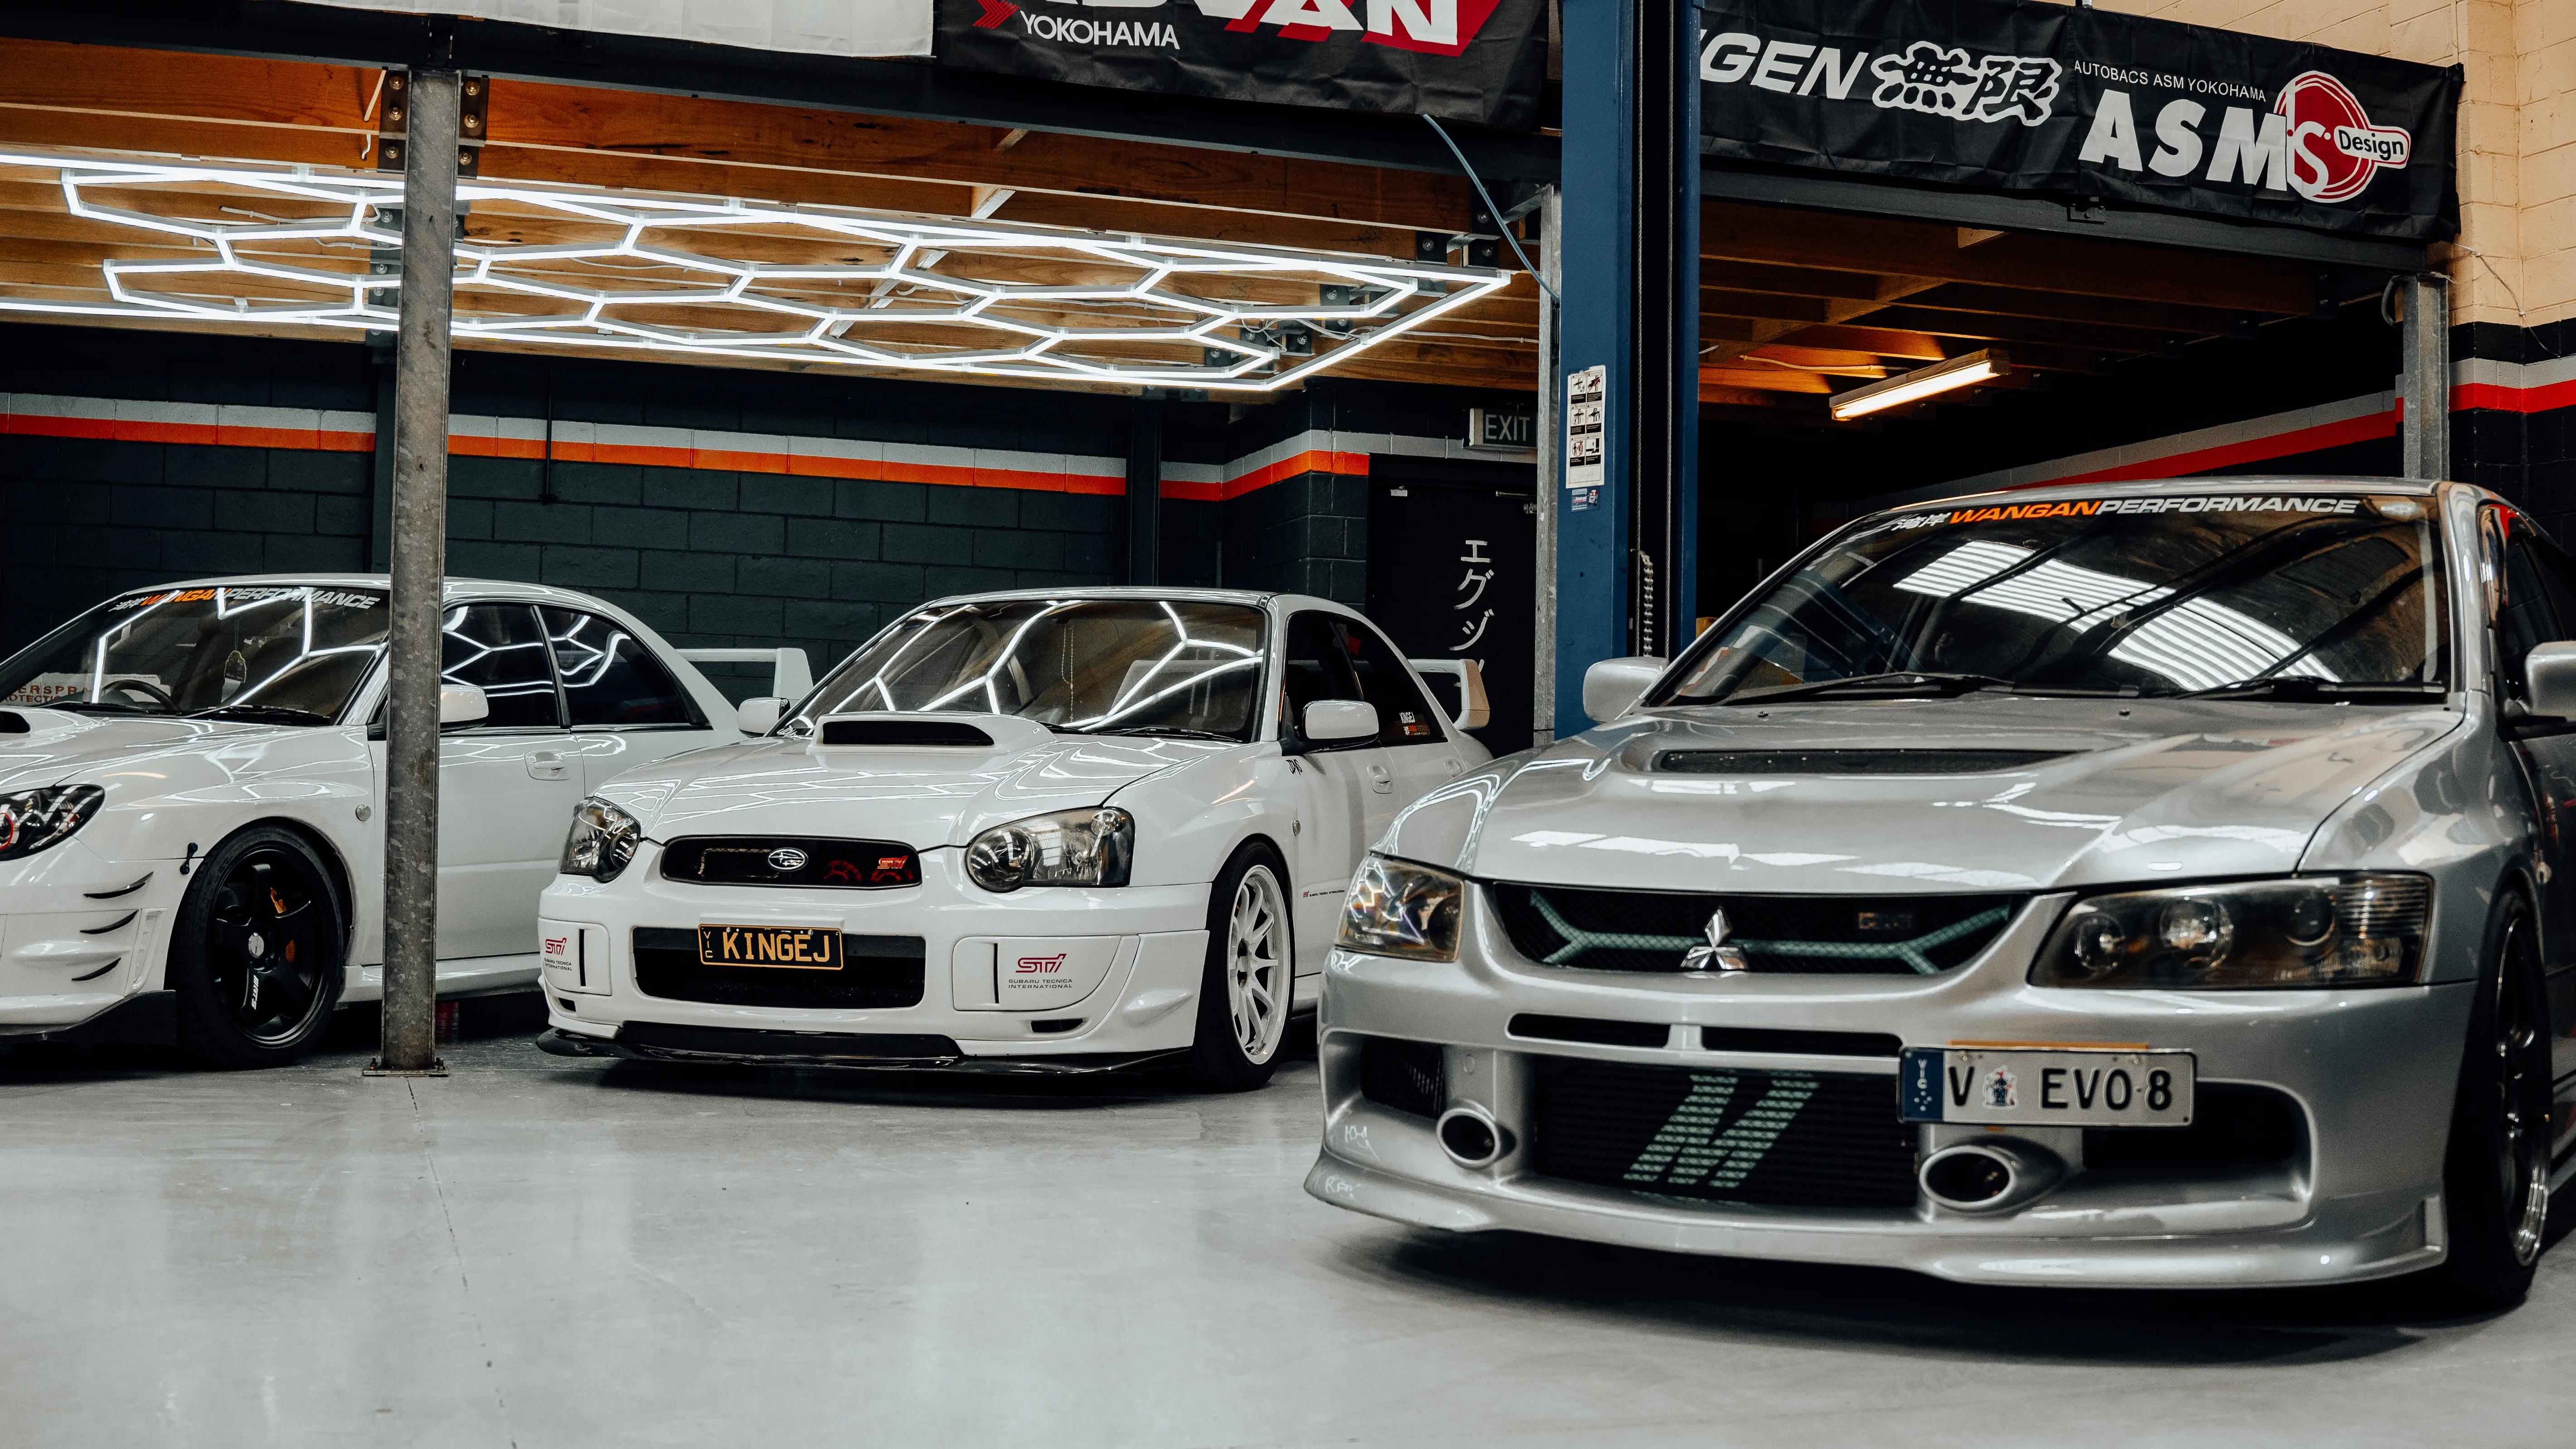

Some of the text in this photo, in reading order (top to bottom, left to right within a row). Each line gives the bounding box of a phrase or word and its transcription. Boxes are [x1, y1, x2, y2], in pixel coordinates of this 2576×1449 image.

[1020, 10, 1180, 49] YOKOHAMA
[1700, 29, 1868, 99] GEN
[2075, 60, 2266, 102] AUTOBACS ASM YOKOHAMA
[2078, 89, 2287, 191] ASM
[2338, 129, 2404, 161] Design
[1485, 414, 1530, 442] EXIT
[1449, 539, 1495, 672] エグジ
[703, 931, 713, 958] VIC
[723, 932, 830, 962] KINGEJ
[1949, 1066, 1974, 1106] V
